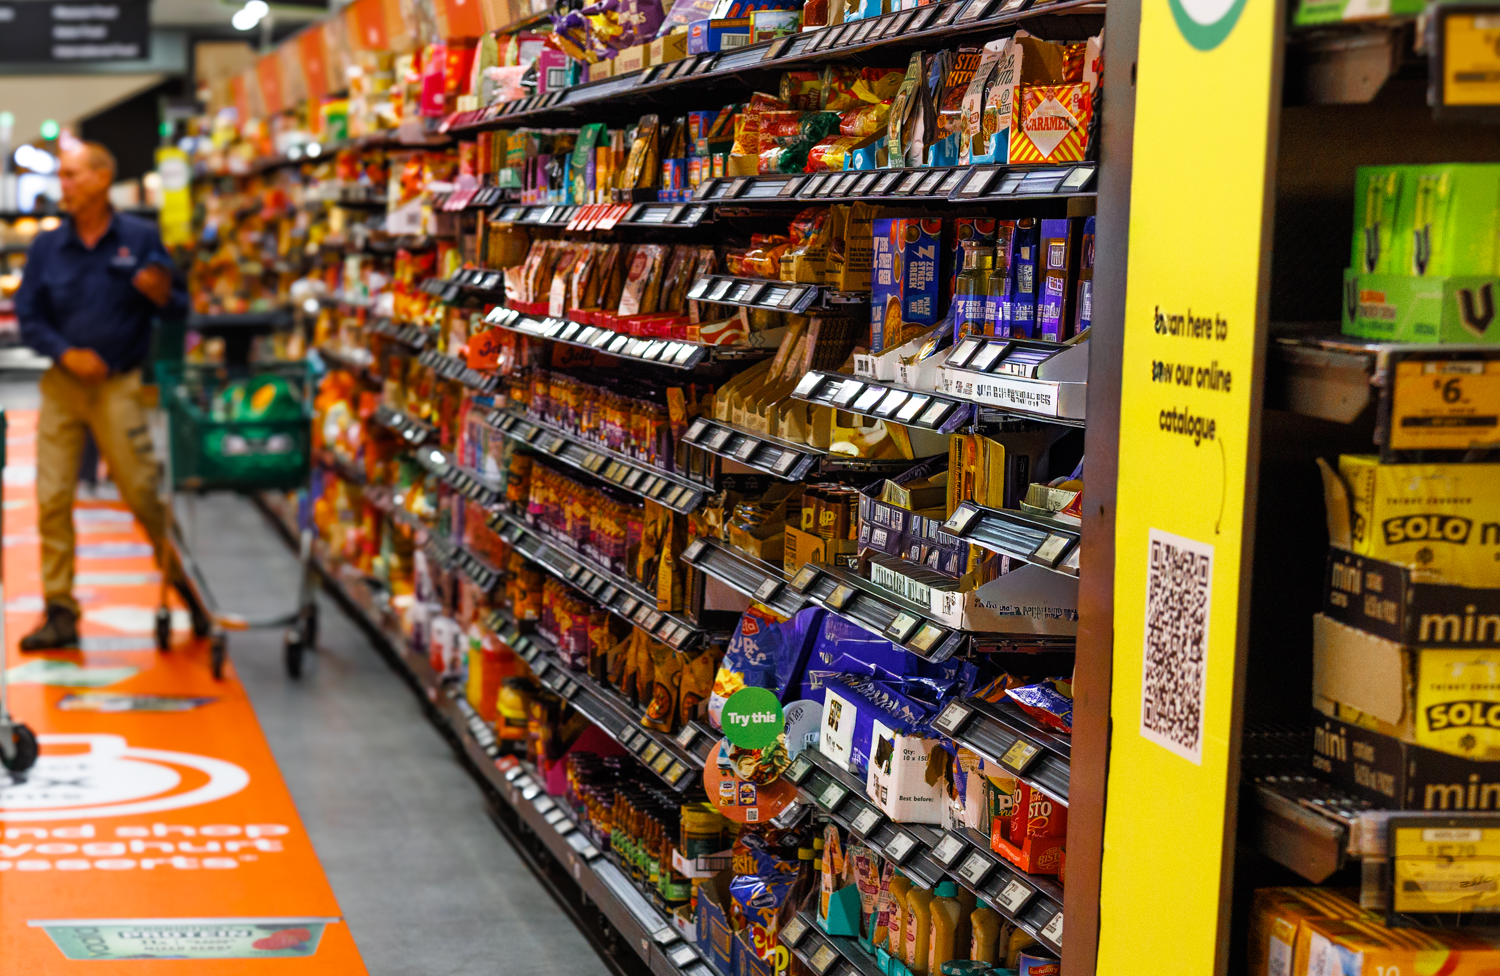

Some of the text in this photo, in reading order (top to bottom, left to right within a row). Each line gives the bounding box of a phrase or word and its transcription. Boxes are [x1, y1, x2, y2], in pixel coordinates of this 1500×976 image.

[1025, 116, 1071, 131] CARAMEL
[1187, 307, 1228, 342] here to
[1175, 364, 1194, 387] our
[1196, 360, 1232, 393] online
[1159, 405, 1216, 447] catalogue
[1386, 516, 1468, 543] SOLO
[1418, 605, 1500, 644] min
[728, 711, 776, 726] Try this
[1424, 774, 1500, 811] min
[116, 823, 289, 839] shop
